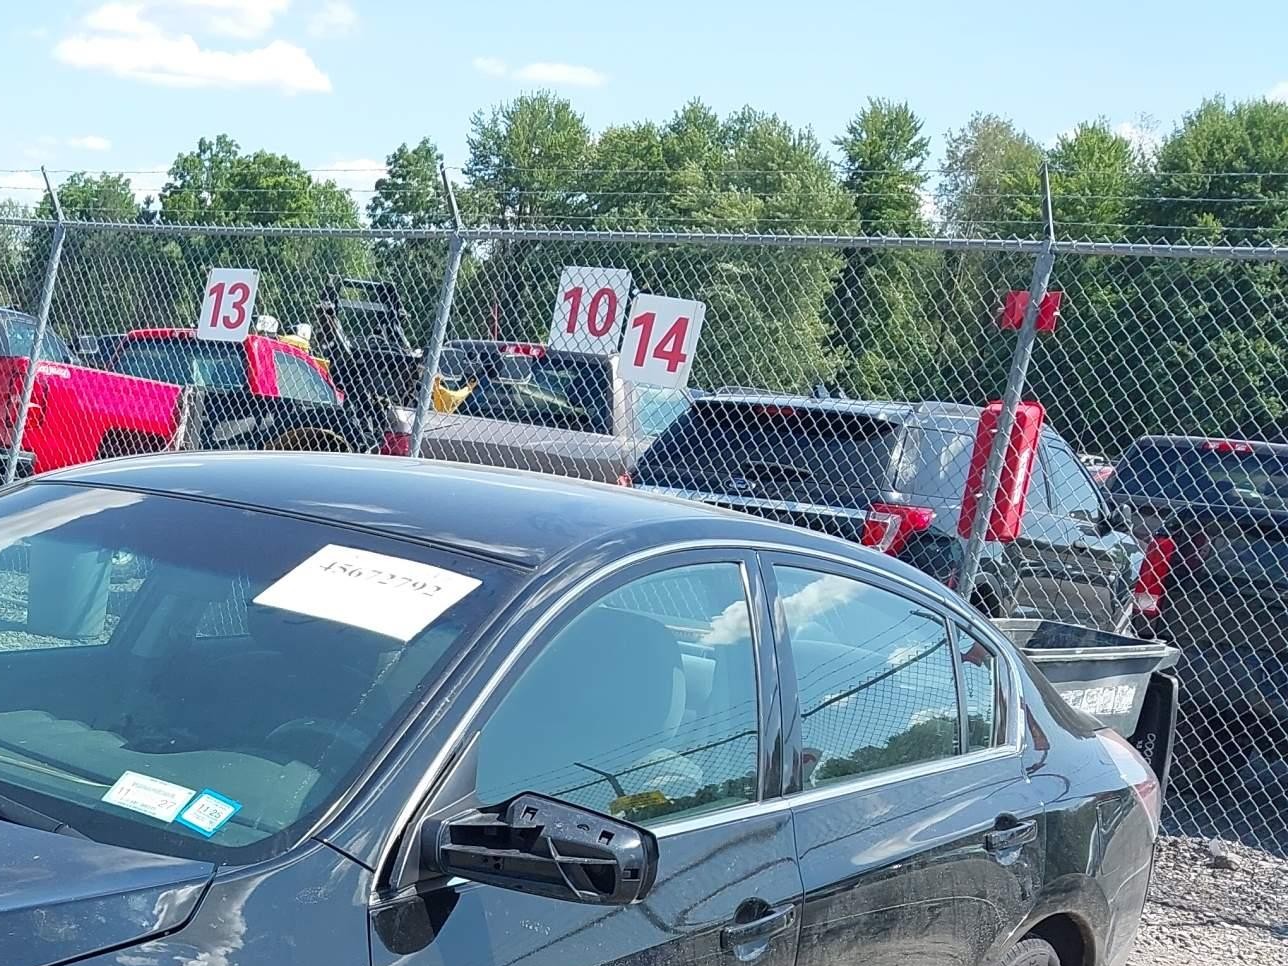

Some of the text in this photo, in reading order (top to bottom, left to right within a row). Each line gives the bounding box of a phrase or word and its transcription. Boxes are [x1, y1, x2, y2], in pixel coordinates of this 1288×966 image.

[208, 282, 251, 330] 13
[563, 286, 618, 338] 10
[631, 311, 690, 373] 14
[319, 561, 443, 597] 45672792
